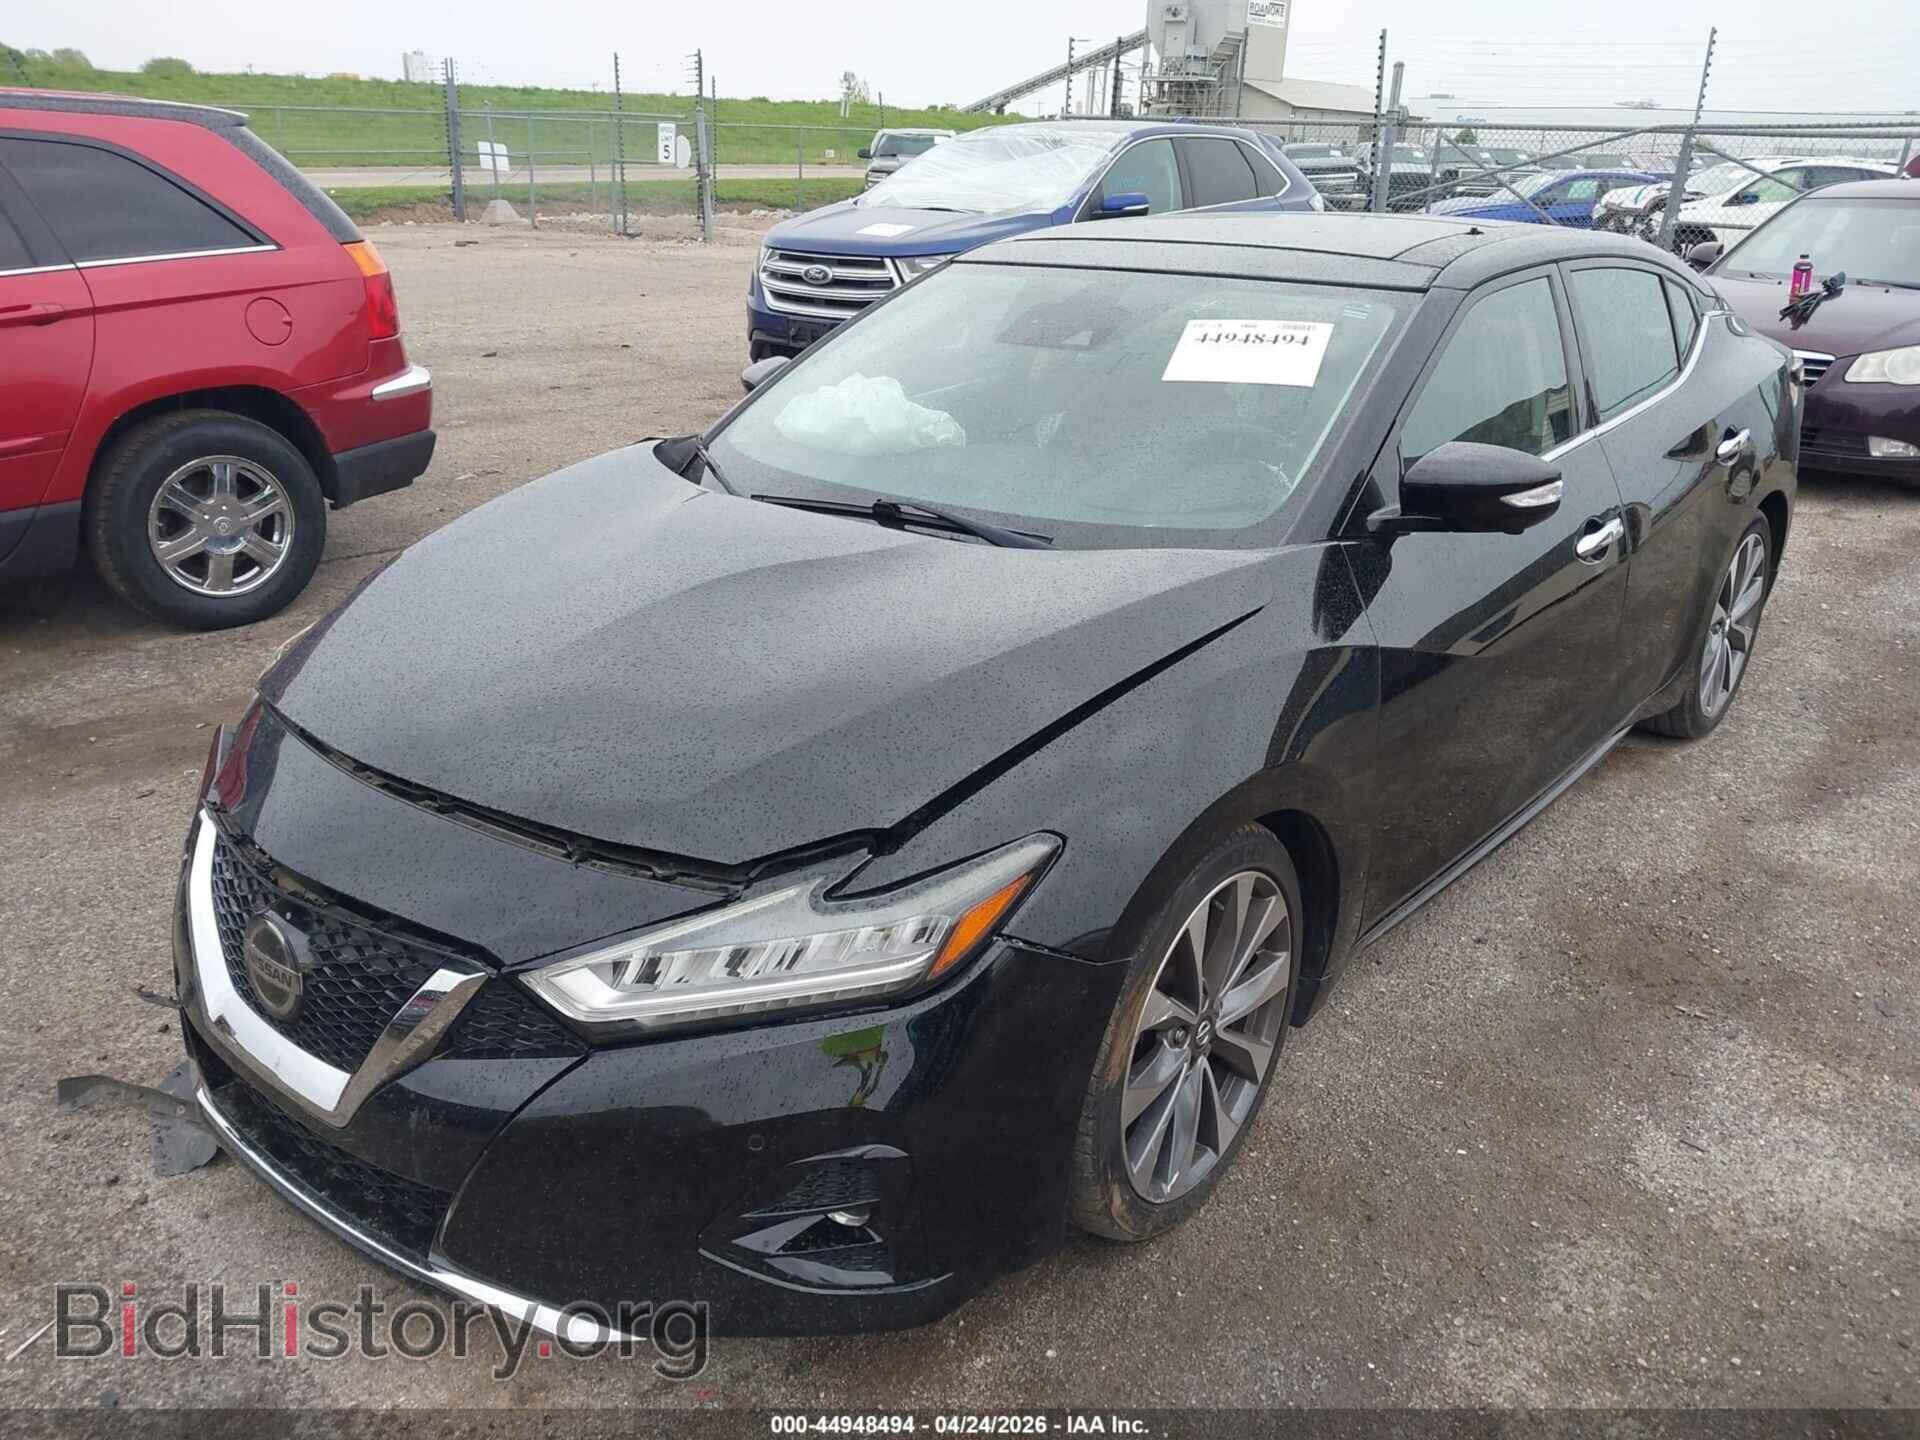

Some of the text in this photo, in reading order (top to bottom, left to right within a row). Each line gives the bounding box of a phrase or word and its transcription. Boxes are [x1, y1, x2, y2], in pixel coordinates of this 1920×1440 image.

[1250, 2, 1285, 17] ROANOKE
[663, 144, 671, 159] 5
[1193, 332, 1309, 346] 44948494
[253, 954, 292, 987] ISSAN
